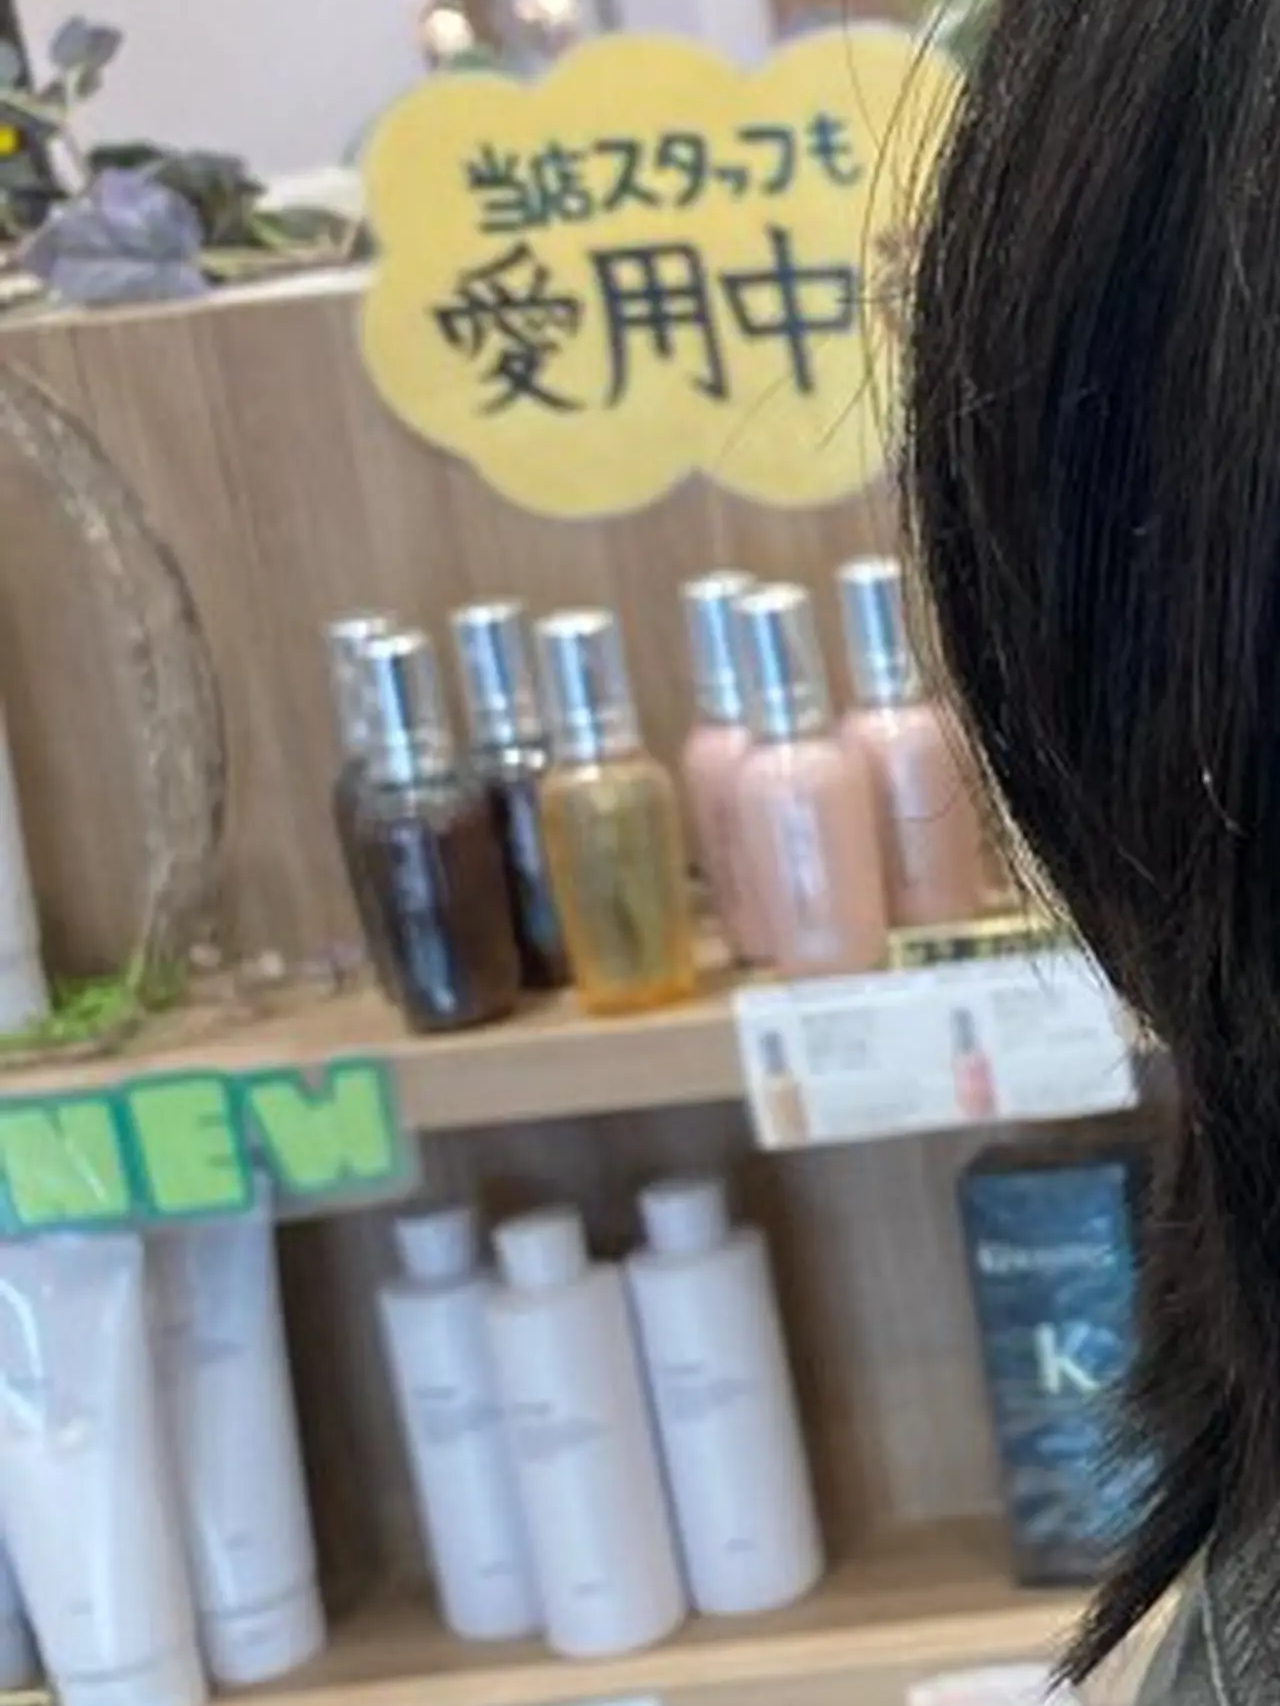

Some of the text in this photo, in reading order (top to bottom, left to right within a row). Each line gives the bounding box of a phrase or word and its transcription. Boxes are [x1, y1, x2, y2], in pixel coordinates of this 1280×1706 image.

[460, 111, 863, 235] 当店スタッフも
[431, 224, 860, 418] 愛用中
[0, 1055, 400, 1229] NEW
[1033, 1321, 1100, 1399] K
